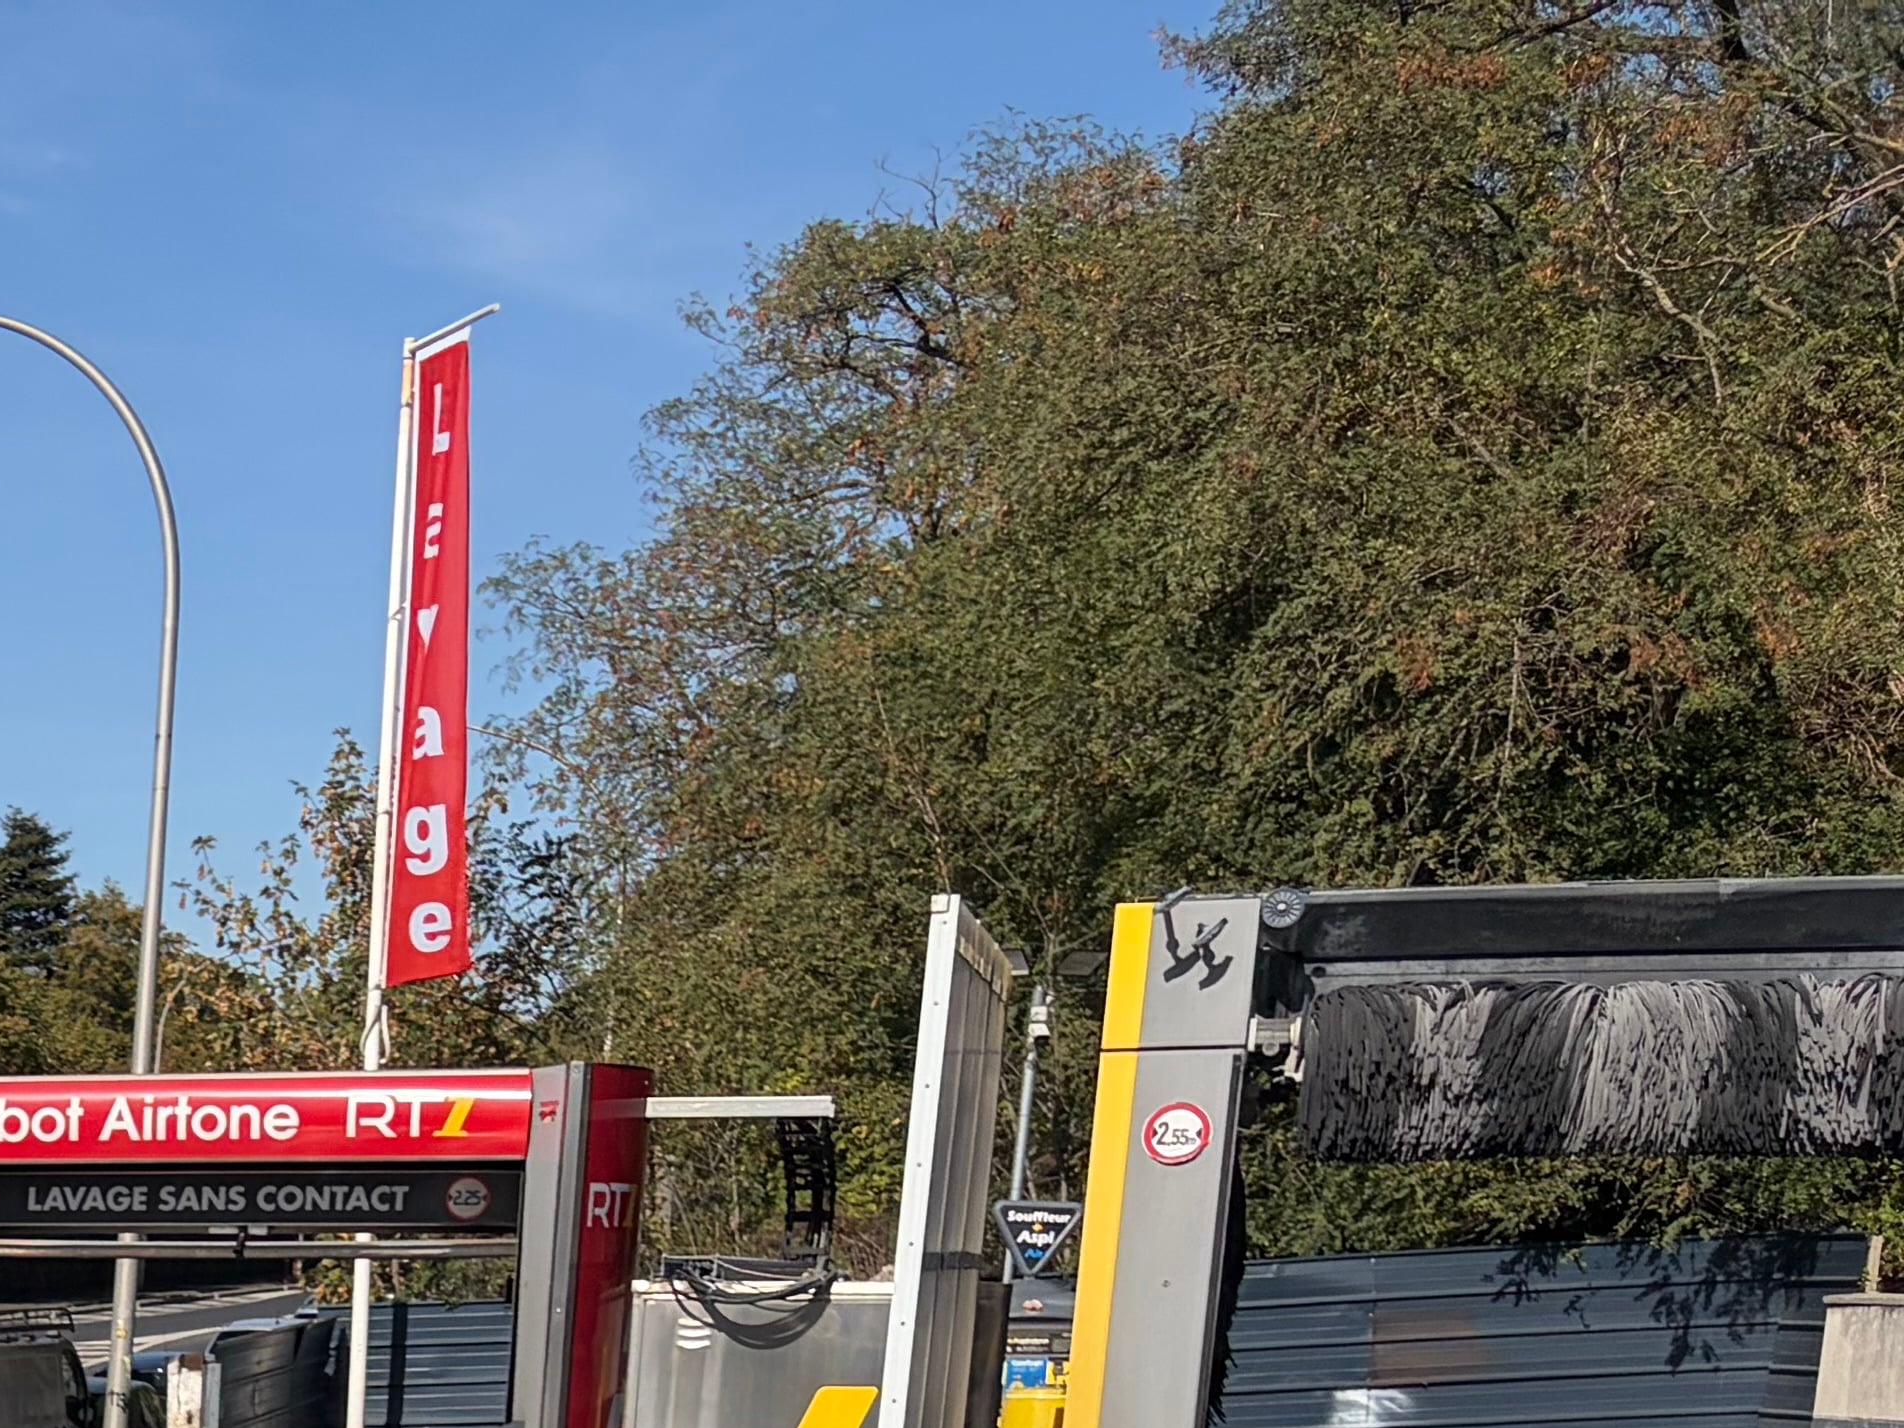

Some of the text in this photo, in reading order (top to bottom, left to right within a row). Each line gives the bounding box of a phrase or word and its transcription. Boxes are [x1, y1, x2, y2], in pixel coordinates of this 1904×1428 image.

[98, 1095, 300, 1142] Airtone
[345, 1093, 476, 1139] RT1
[26, 1185, 410, 1212] LAVAGE SANS CONTACT
[1006, 1210, 1072, 1223] Souffleur
